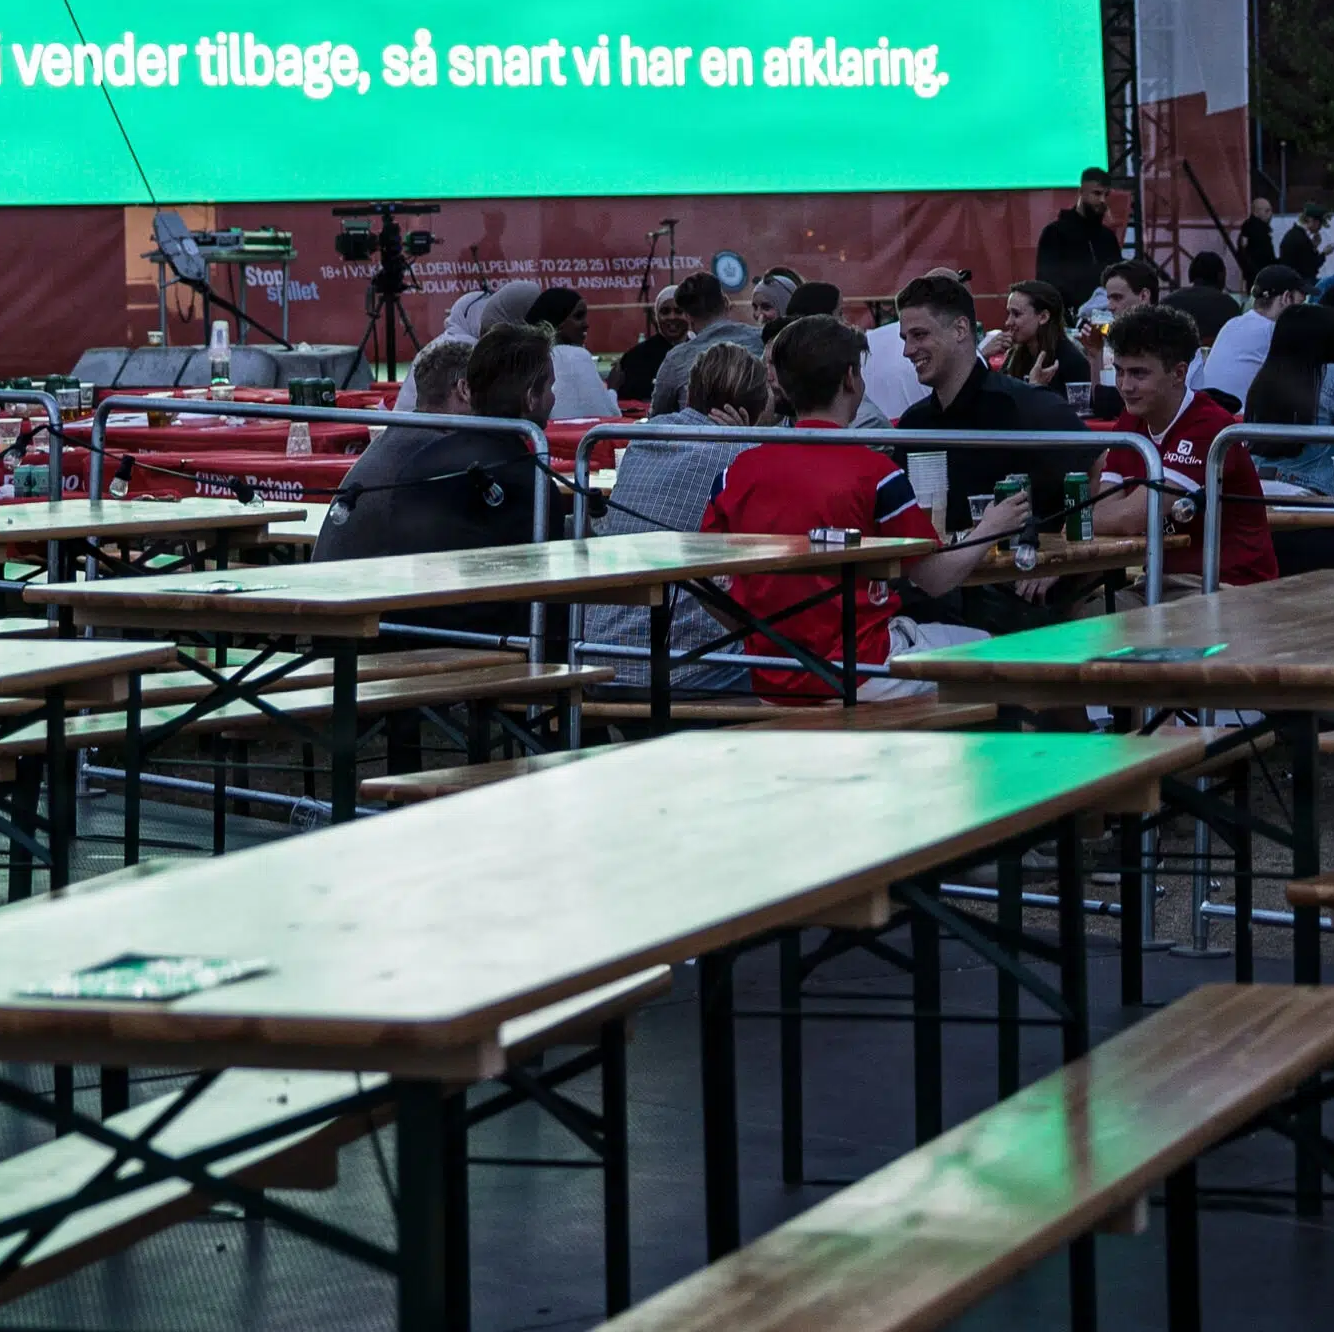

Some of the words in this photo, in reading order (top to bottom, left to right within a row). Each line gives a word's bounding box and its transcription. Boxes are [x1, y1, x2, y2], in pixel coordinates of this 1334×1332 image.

[12, 32, 187, 87] vender
[195, 32, 370, 99] tilbage,
[383, 28, 437, 86] så
[449, 39, 567, 86] snart
[573, 35, 610, 86] vi
[621, 35, 692, 86] har
[700, 47, 753, 86] en
[763, 37, 949, 97] afklaring.
[245, 265, 284, 288] Stop
[539, 259, 556, 273] 70
[557, 259, 572, 273] 22
